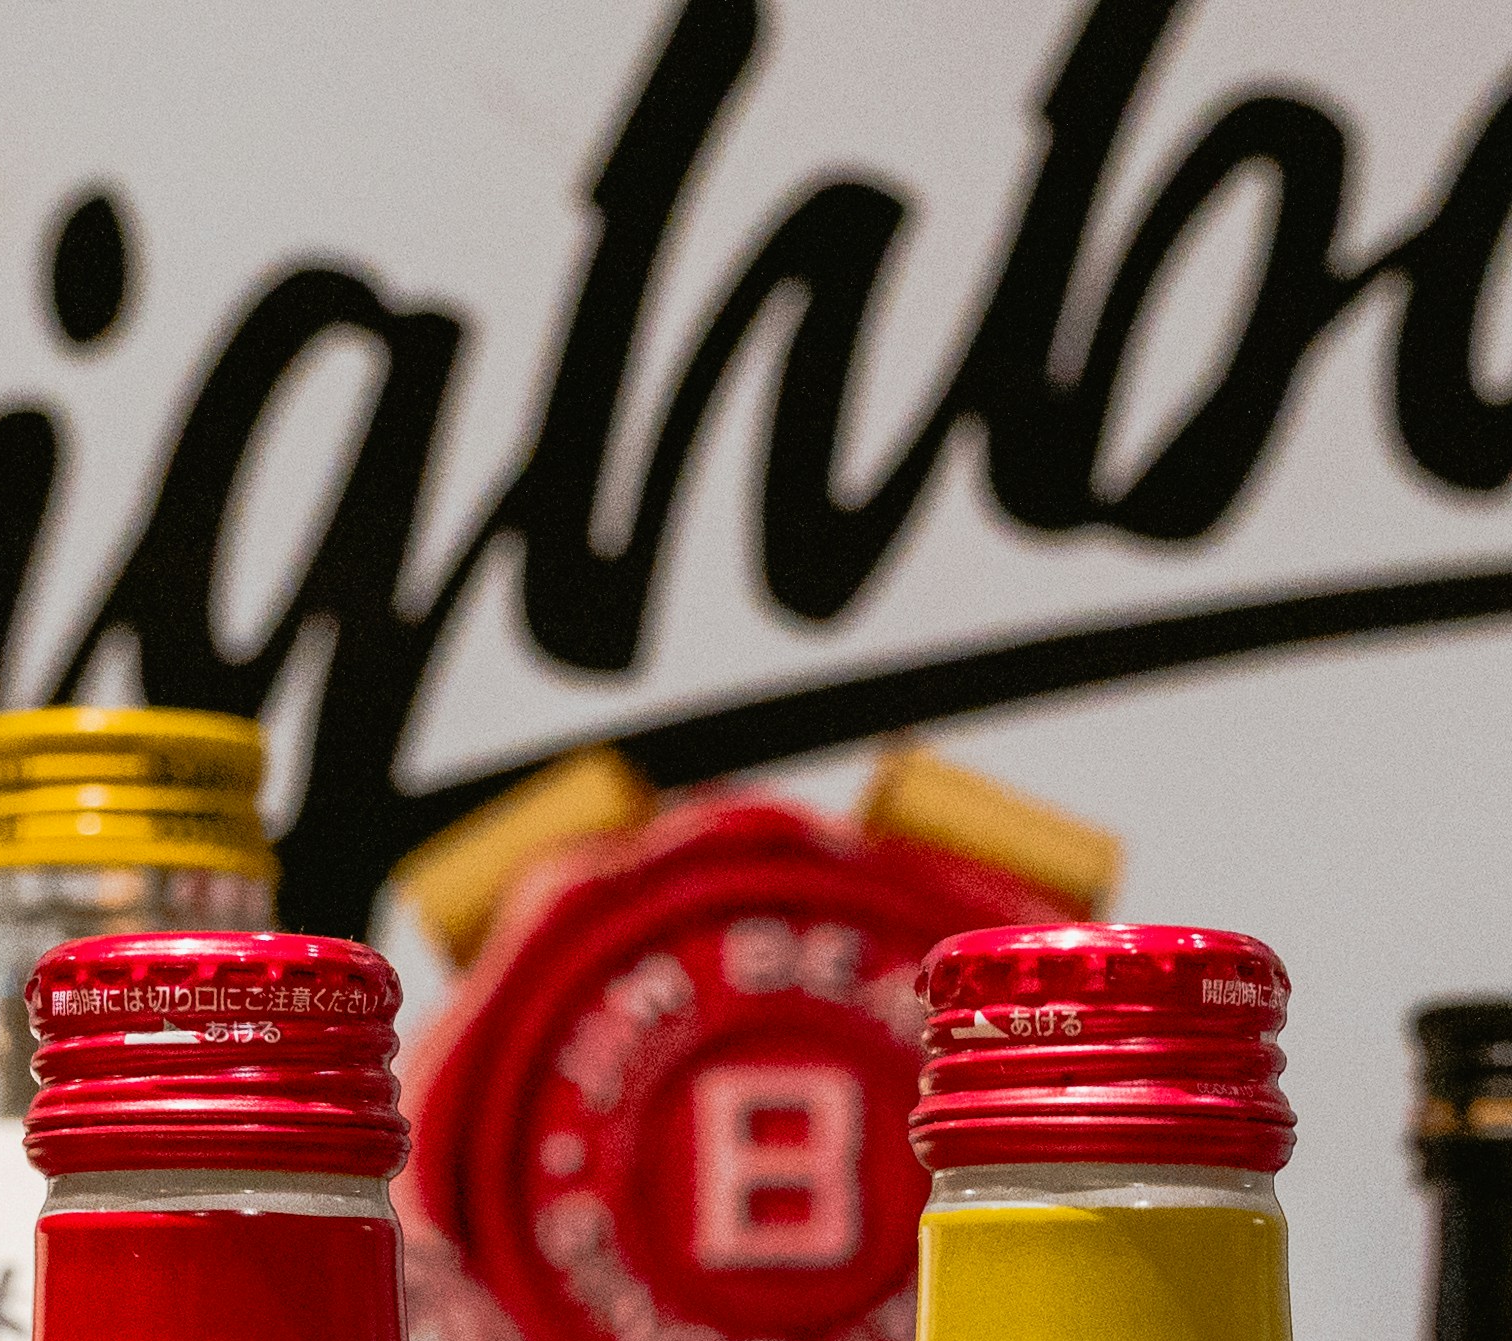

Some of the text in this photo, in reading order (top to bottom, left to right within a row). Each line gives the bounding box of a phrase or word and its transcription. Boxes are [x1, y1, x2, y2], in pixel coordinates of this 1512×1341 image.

[51, 984, 380, 1017] 開閉時には切り口にご注意ください
[204, 1020, 282, 1044] あける
[1007, 1008, 1085, 1038] あける
